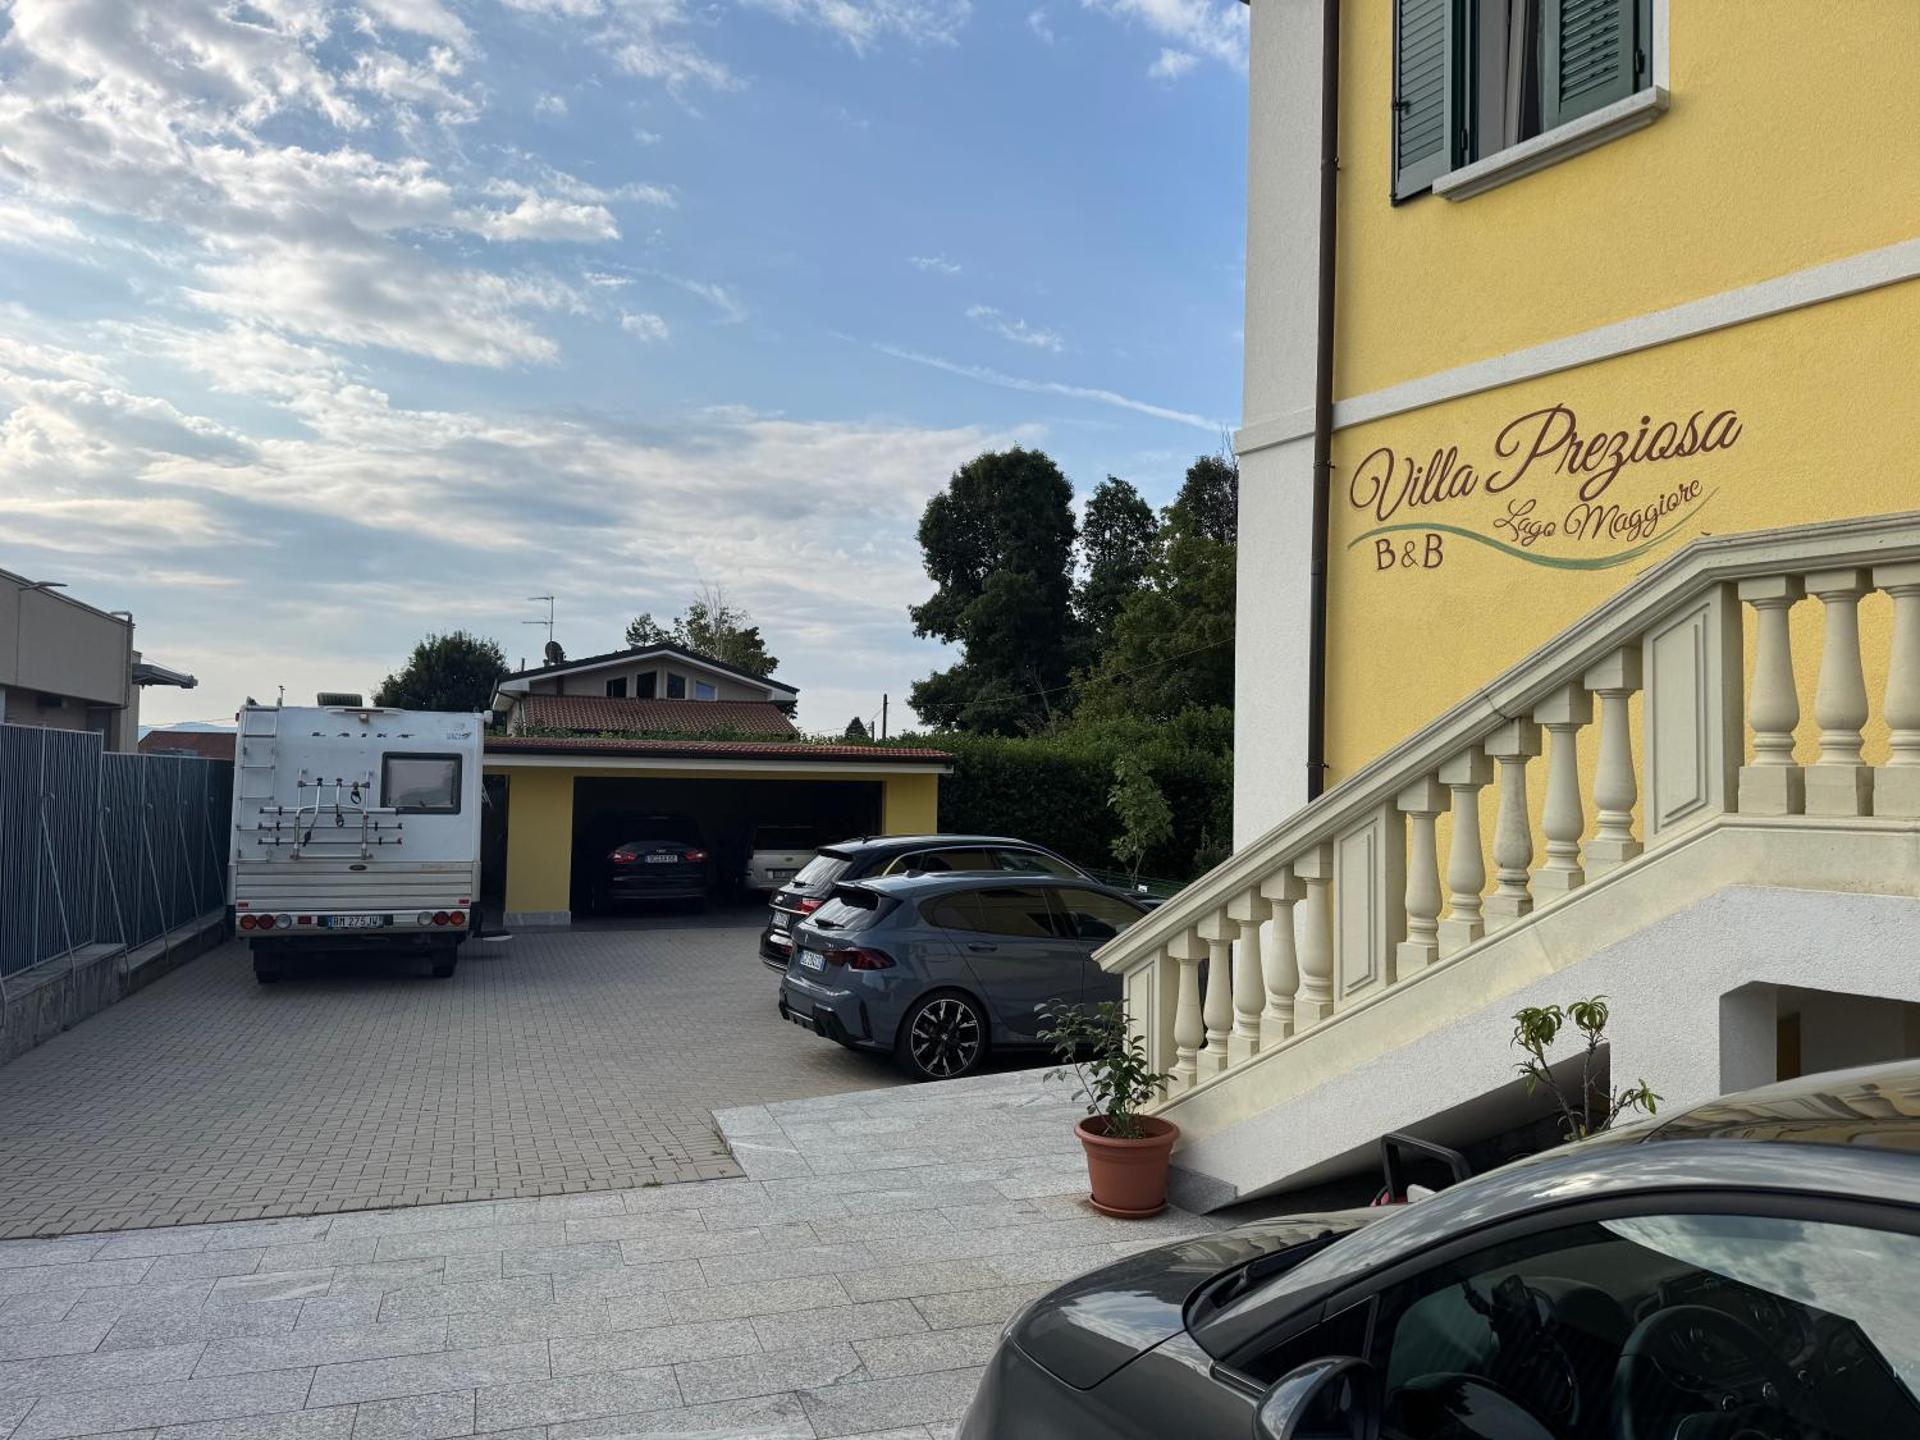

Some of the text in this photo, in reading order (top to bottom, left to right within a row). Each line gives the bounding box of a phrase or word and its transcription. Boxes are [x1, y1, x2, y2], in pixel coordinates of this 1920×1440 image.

[1350, 403, 1743, 522] Villa Preziosa
[1494, 479, 1704, 548] Lago Maggiore
